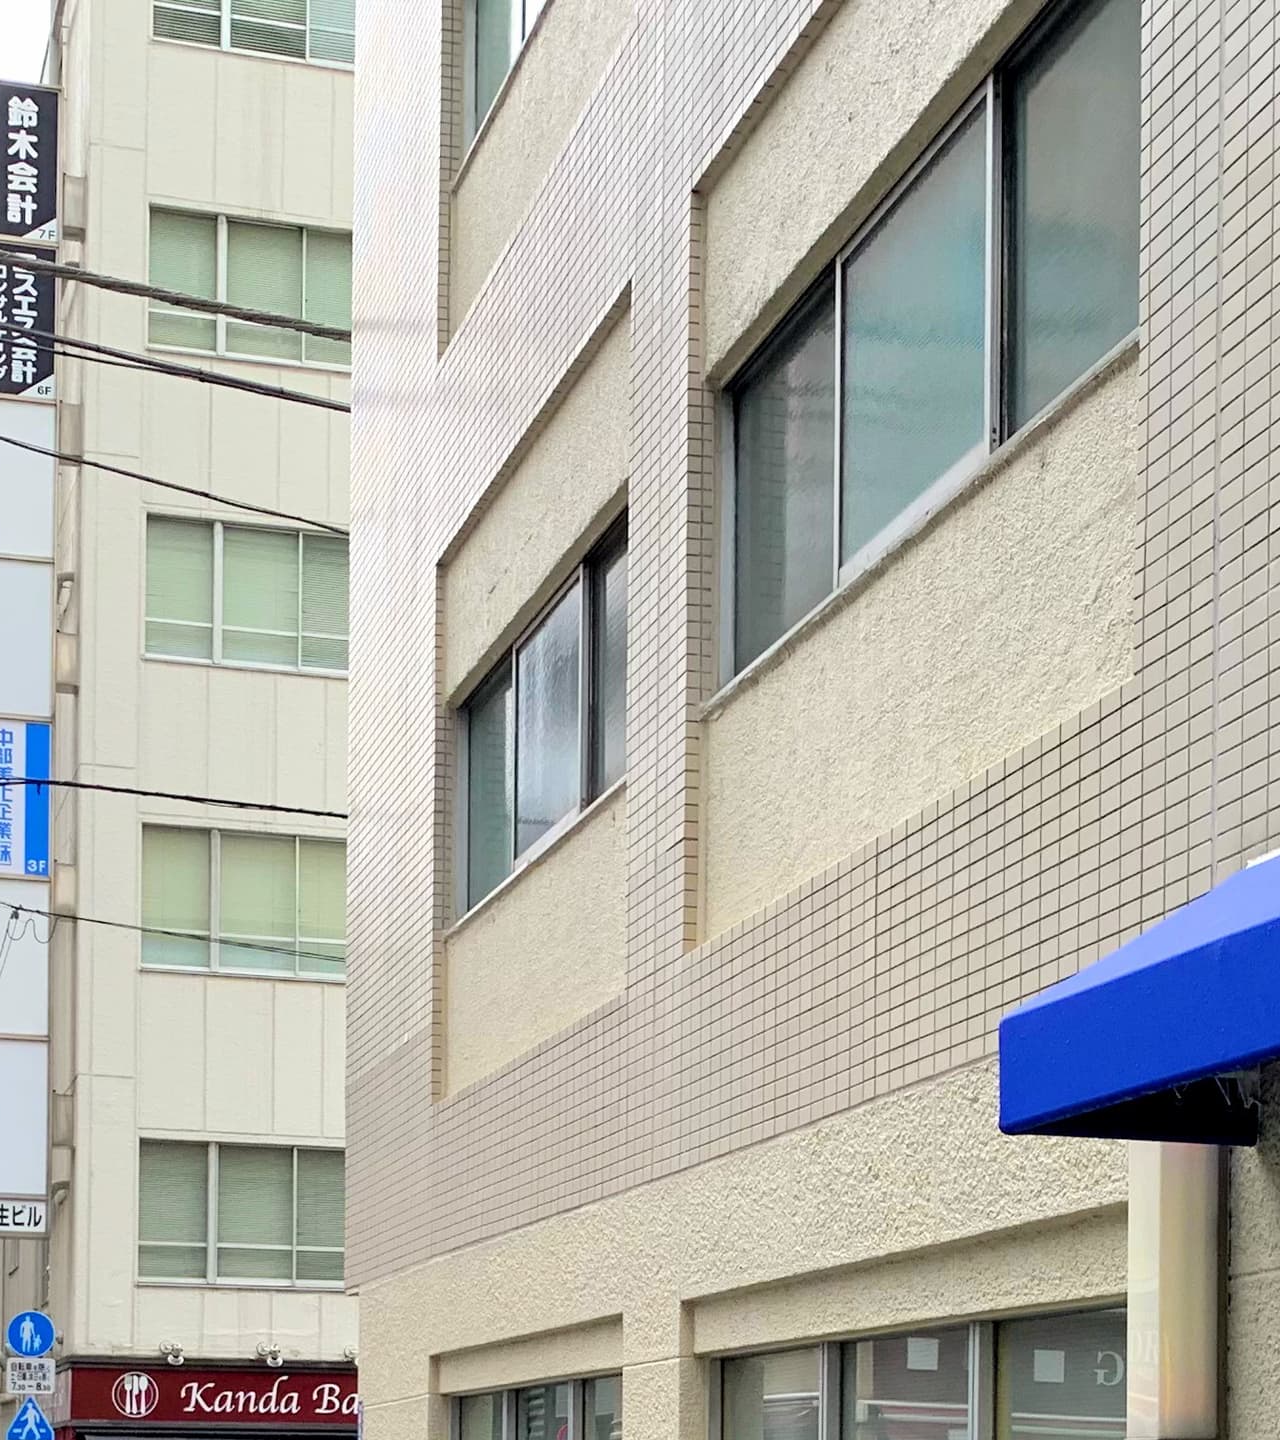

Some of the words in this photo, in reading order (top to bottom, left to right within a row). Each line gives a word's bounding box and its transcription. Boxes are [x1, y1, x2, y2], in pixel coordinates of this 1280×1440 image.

[7, 96, 39, 226] 鈴木会計
[39, 228, 55, 240] 7F
[37, 386, 52, 395] 6F
[27, 859, 47, 873] 3F
[180, 1376, 301, 1415] Kanda
